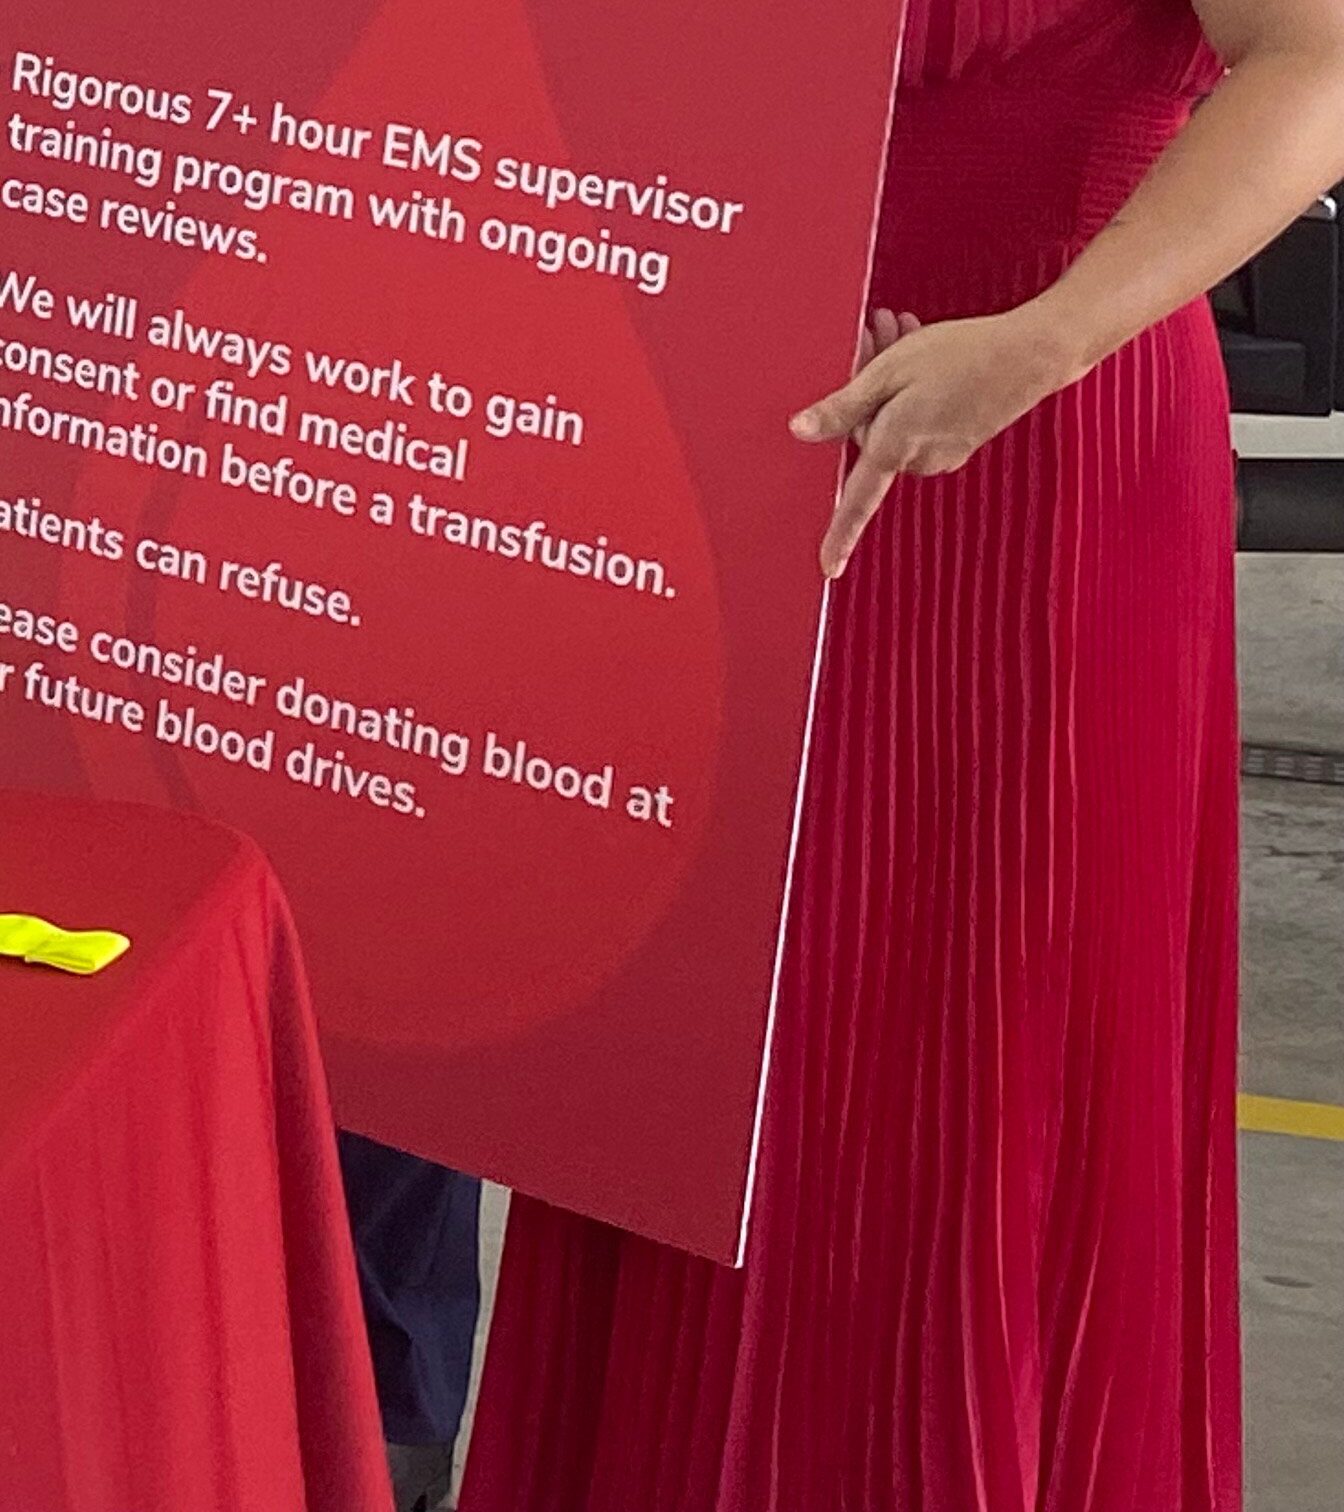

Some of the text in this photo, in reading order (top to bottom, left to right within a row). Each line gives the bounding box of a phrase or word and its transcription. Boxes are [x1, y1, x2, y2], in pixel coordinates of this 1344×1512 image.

[9, 114, 669, 294] training program with ongoing
[13, 52, 743, 232] Rigorous 7+ hour EMS supervisor
[3, 180, 266, 262] case reviews.
[67, 294, 136, 338] will
[149, 310, 290, 377] always
[306, 352, 415, 405] work
[428, 373, 471, 416] to
[486, 395, 582, 444] gain
[151, 378, 195, 411] or
[205, 381, 287, 435] find
[300, 413, 467, 479] medical
[137, 540, 206, 583] can
[221, 562, 359, 625] refuse.
[222, 444, 356, 514] before
[370, 494, 393, 524] a
[409, 495, 674, 597] transfusion.
[25, 663, 143, 731] future
[157, 700, 273, 770] blood
[287, 743, 424, 816] drives.
[91, 633, 265, 704] consider
[278, 678, 469, 774] donating
[484, 733, 612, 808] blood
[627, 787, 673, 826] at
